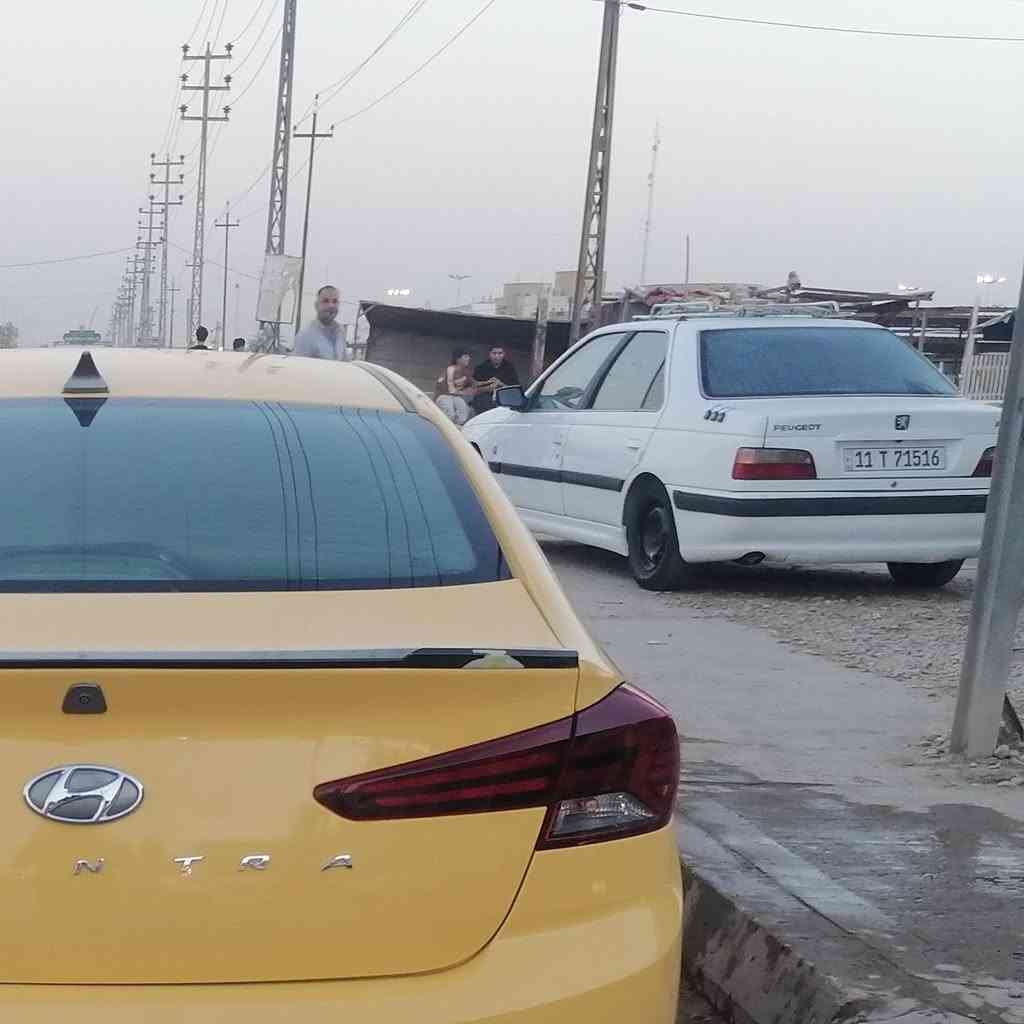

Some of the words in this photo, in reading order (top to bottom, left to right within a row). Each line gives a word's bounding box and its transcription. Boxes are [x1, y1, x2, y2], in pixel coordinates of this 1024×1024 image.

[773, 423, 823, 432] PEUGEOT
[855, 450, 873, 468] 11
[879, 450, 888, 468] T
[894, 449, 940, 468] 71516
